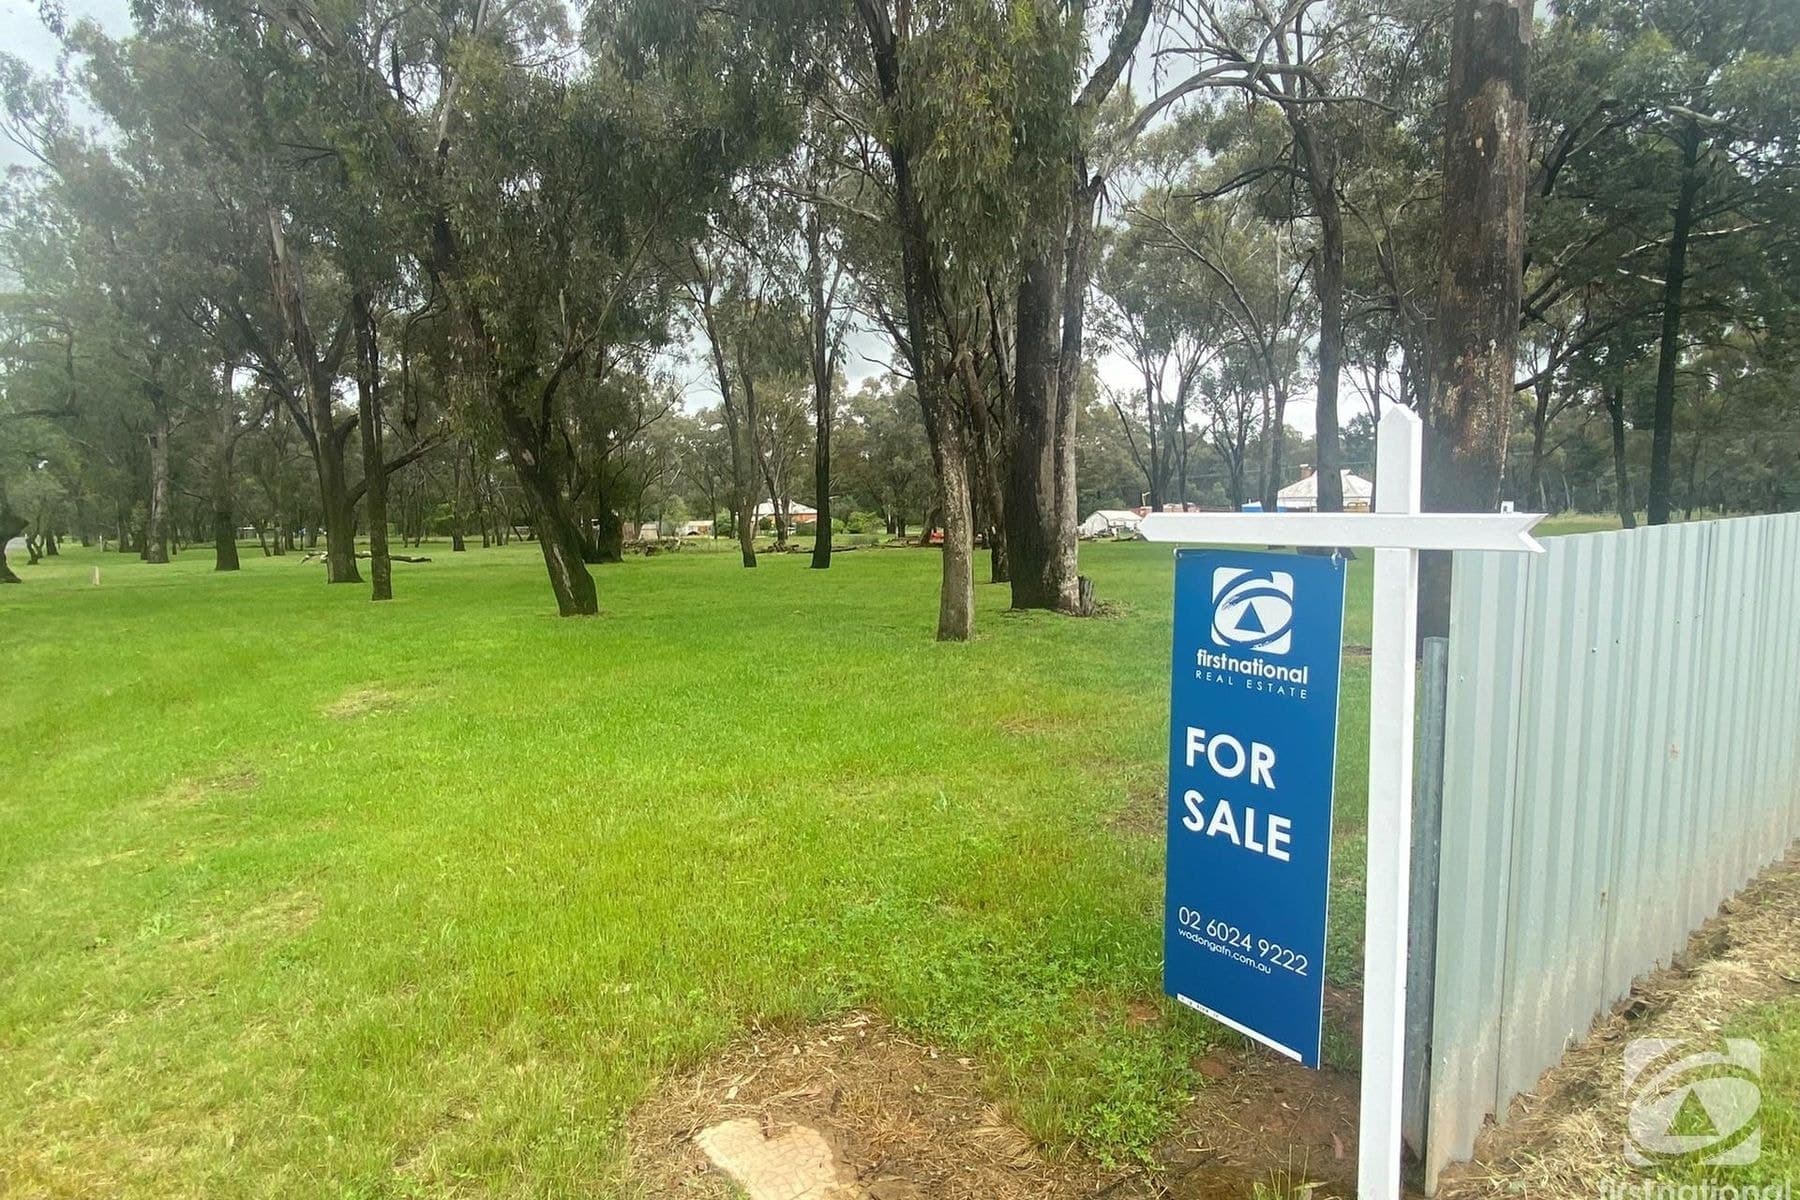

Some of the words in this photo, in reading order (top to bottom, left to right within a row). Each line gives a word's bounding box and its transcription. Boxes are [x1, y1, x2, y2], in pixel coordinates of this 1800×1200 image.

[1195, 670, 1234, 686] REAL
[1246, 679, 1307, 699] ESTATE
[1196, 649, 1309, 684] firstnational
[1186, 726, 1276, 790] FOR
[1182, 789, 1291, 862] SALE
[1178, 906, 1201, 931] 02
[1206, 918, 1252, 952] 6024
[1257, 939, 1308, 977] 9222
[1178, 928, 1272, 974] wodongafn.com.au
